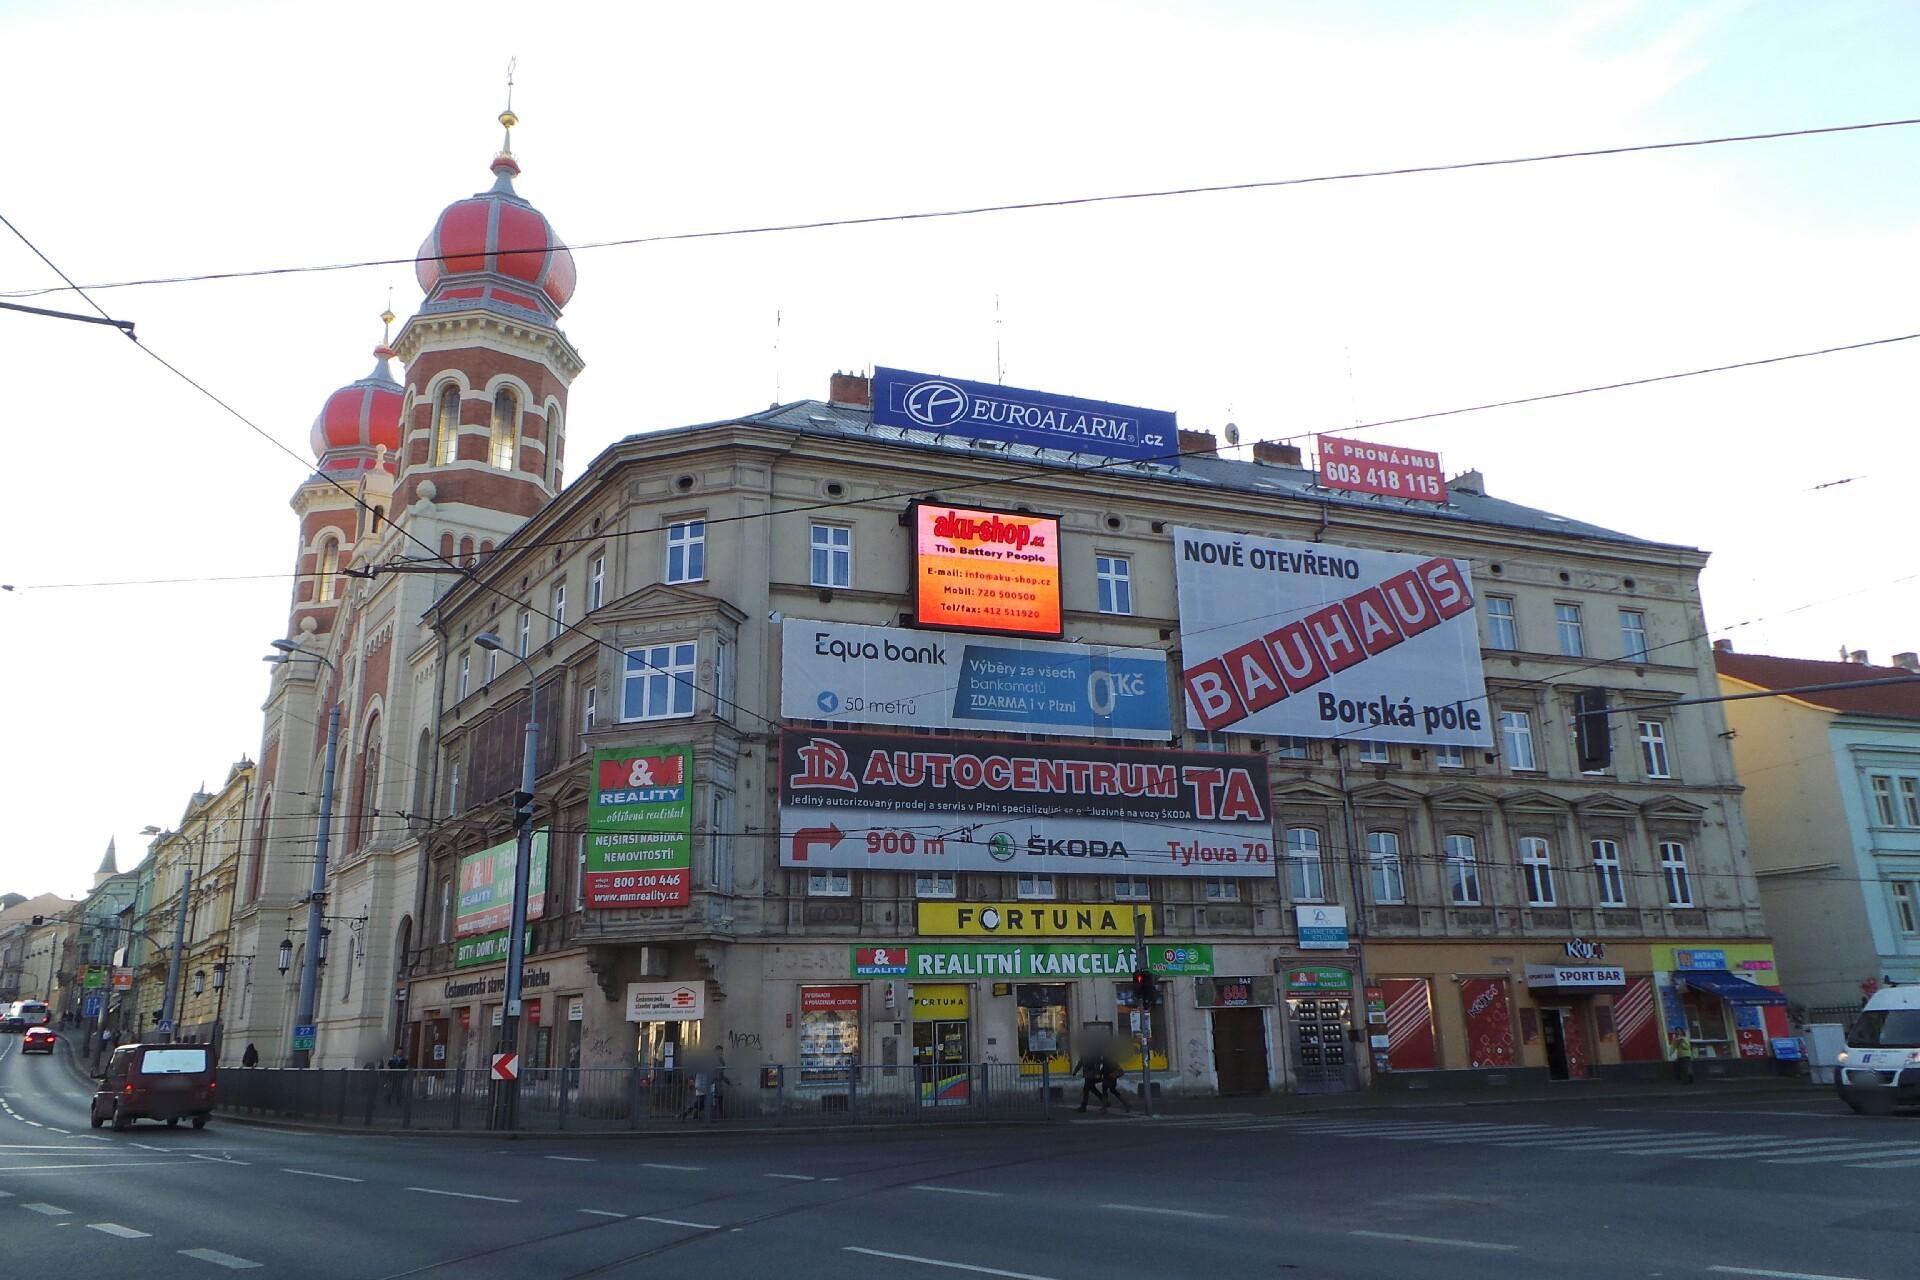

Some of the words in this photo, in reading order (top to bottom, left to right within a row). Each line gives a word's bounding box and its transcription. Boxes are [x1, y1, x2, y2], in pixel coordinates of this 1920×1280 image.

[971, 399, 1128, 440] EUROALARM
[1323, 442, 1334, 454] K
[1344, 444, 1436, 469] PRONÁJMU
[1326, 462, 1361, 484] 603
[1366, 467, 1400, 490] 418
[1405, 473, 1439, 495] 115
[935, 544, 956, 554] The
[959, 546, 1003, 560] Battery
[1006, 551, 1046, 562] People
[1184, 539, 1243, 567] NOVĚ
[1250, 548, 1359, 580] OTEVŘENO
[927, 567, 963, 578] E-mail:
[965, 570, 1051, 586] info@aku-shop.cz
[944, 586, 975, 596] Mobil:
[978, 588, 996, 598] 720
[940, 603, 981, 614] Tel/fax:
[983, 607, 1000, 616] 412
[1004, 608, 1040, 618] 511920
[815, 632, 879, 663] Equa
[884, 640, 947, 665] bank
[1188, 562, 1463, 722] BAUHAUS
[969, 659, 1017, 680] Výběry
[1020, 667, 1035, 678] ze
[1038, 665, 1076, 680] všech
[970, 677, 1047, 695] bankomatů
[1116, 673, 1145, 697] Kč
[845, 696, 865, 712] 50
[869, 698, 916, 716] metrů
[970, 694, 1027, 710] ZDARMA
[1038, 701, 1046, 711] v
[1049, 699, 1076, 713] Plzni
[1318, 692, 1415, 727] Borská
[1423, 699, 1481, 734] pole
[600, 789, 680, 804] REALITY
[863, 750, 1178, 798] AUTOCENTRUM
[1182, 766, 1265, 821] TA
[826, 797, 893, 810] autorizovaný
[895, 800, 926, 812] prodej
[937, 801, 966, 811] servis
[976, 802, 1000, 812] Plzni
[1126, 810, 1137, 818] na
[1139, 811, 1159, 820] vozy
[1161, 809, 1191, 819] ŠKODA
[866, 832, 915, 855] 900
[923, 838, 945, 855] m
[1027, 834, 1129, 858] ŠKODA
[1167, 840, 1238, 867] Tylova
[1242, 843, 1268, 863] 70
[613, 877, 634, 888] 800
[637, 876, 656, 887] 100
[659, 874, 680, 886] 446
[594, 890, 679, 902] www.mmreality.cz
[958, 907, 1118, 932] FORTUNA
[857, 966, 907, 975] REALITY
[918, 948, 1022, 976] REALITNÍ
[1030, 947, 1137, 976] KANCELÁŘ
[1559, 971, 1596, 981] SPORT
[1597, 970, 1621, 981] BAR
[915, 998, 964, 1007] FORTUNA
